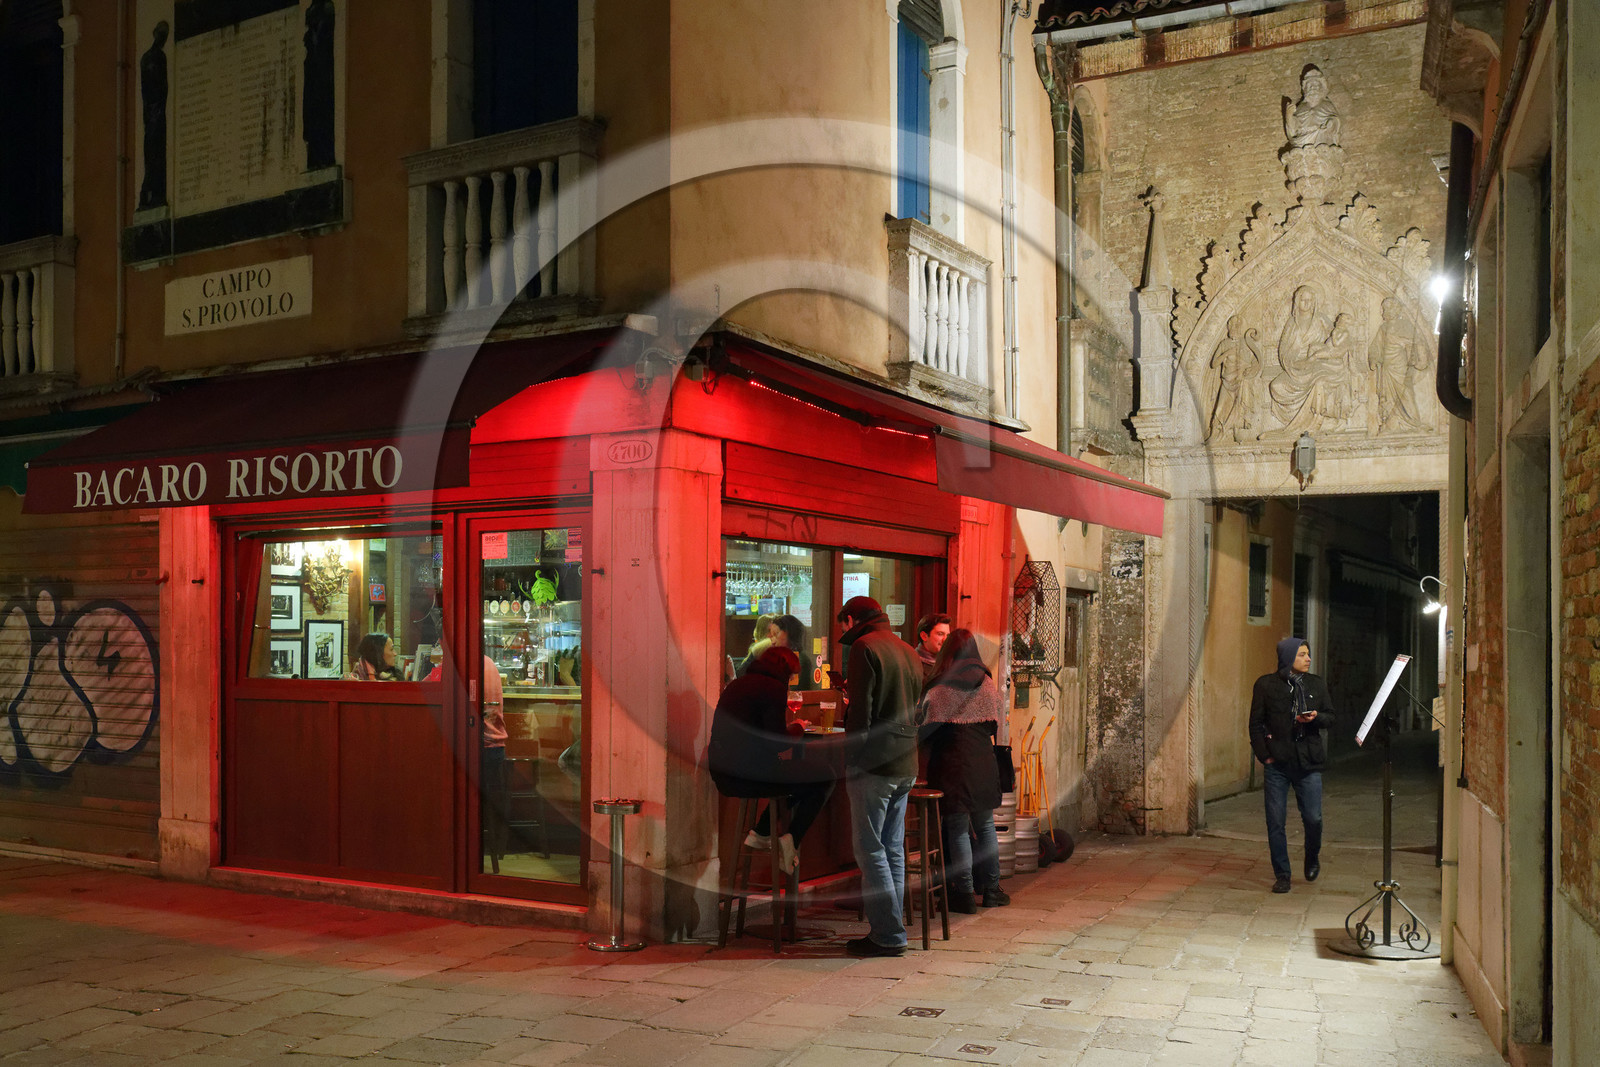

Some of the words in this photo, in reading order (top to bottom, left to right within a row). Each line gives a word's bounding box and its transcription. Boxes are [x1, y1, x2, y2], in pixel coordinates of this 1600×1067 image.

[202, 267, 272, 299] CAMPO
[611, 443, 647, 460] 4700
[73, 461, 208, 508] BACARO
[225, 445, 403, 499] RISORTO
